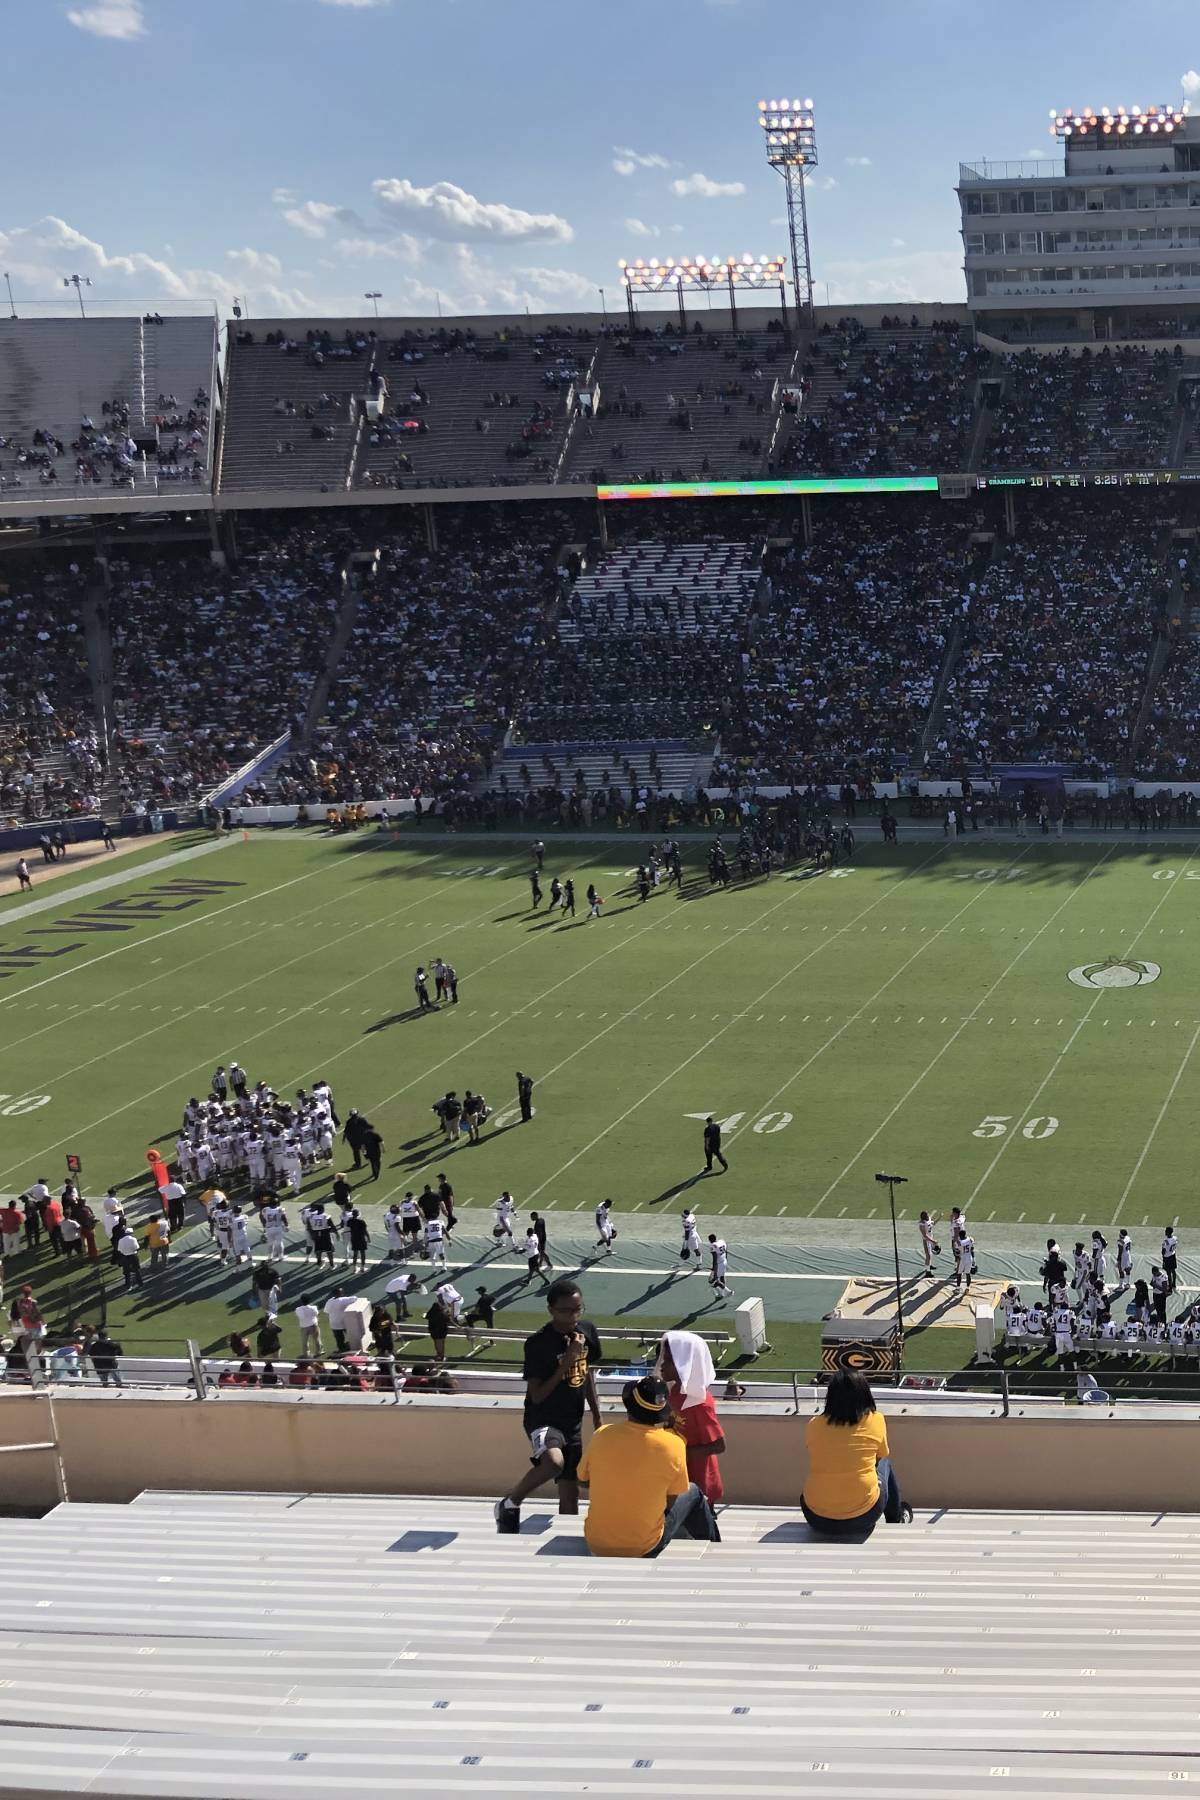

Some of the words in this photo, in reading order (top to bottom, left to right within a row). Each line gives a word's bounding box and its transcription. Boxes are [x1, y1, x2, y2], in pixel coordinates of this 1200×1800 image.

[1030, 476, 1043, 486] 10
[1165, 474, 1172, 483] 7
[23, 878, 247, 934] VIEW
[711, 1111, 794, 1134] 40
[972, 1116, 1060, 1139] 50
[1012, 1318, 1019, 1326] 21
[1030, 1314, 1038, 1323] 46
[1058, 1315, 1068, 1324] 43
[1080, 1325, 1090, 1334] 23
[1128, 1328, 1138, 1336] 25
[1173, 1329, 1182, 1338] 45
